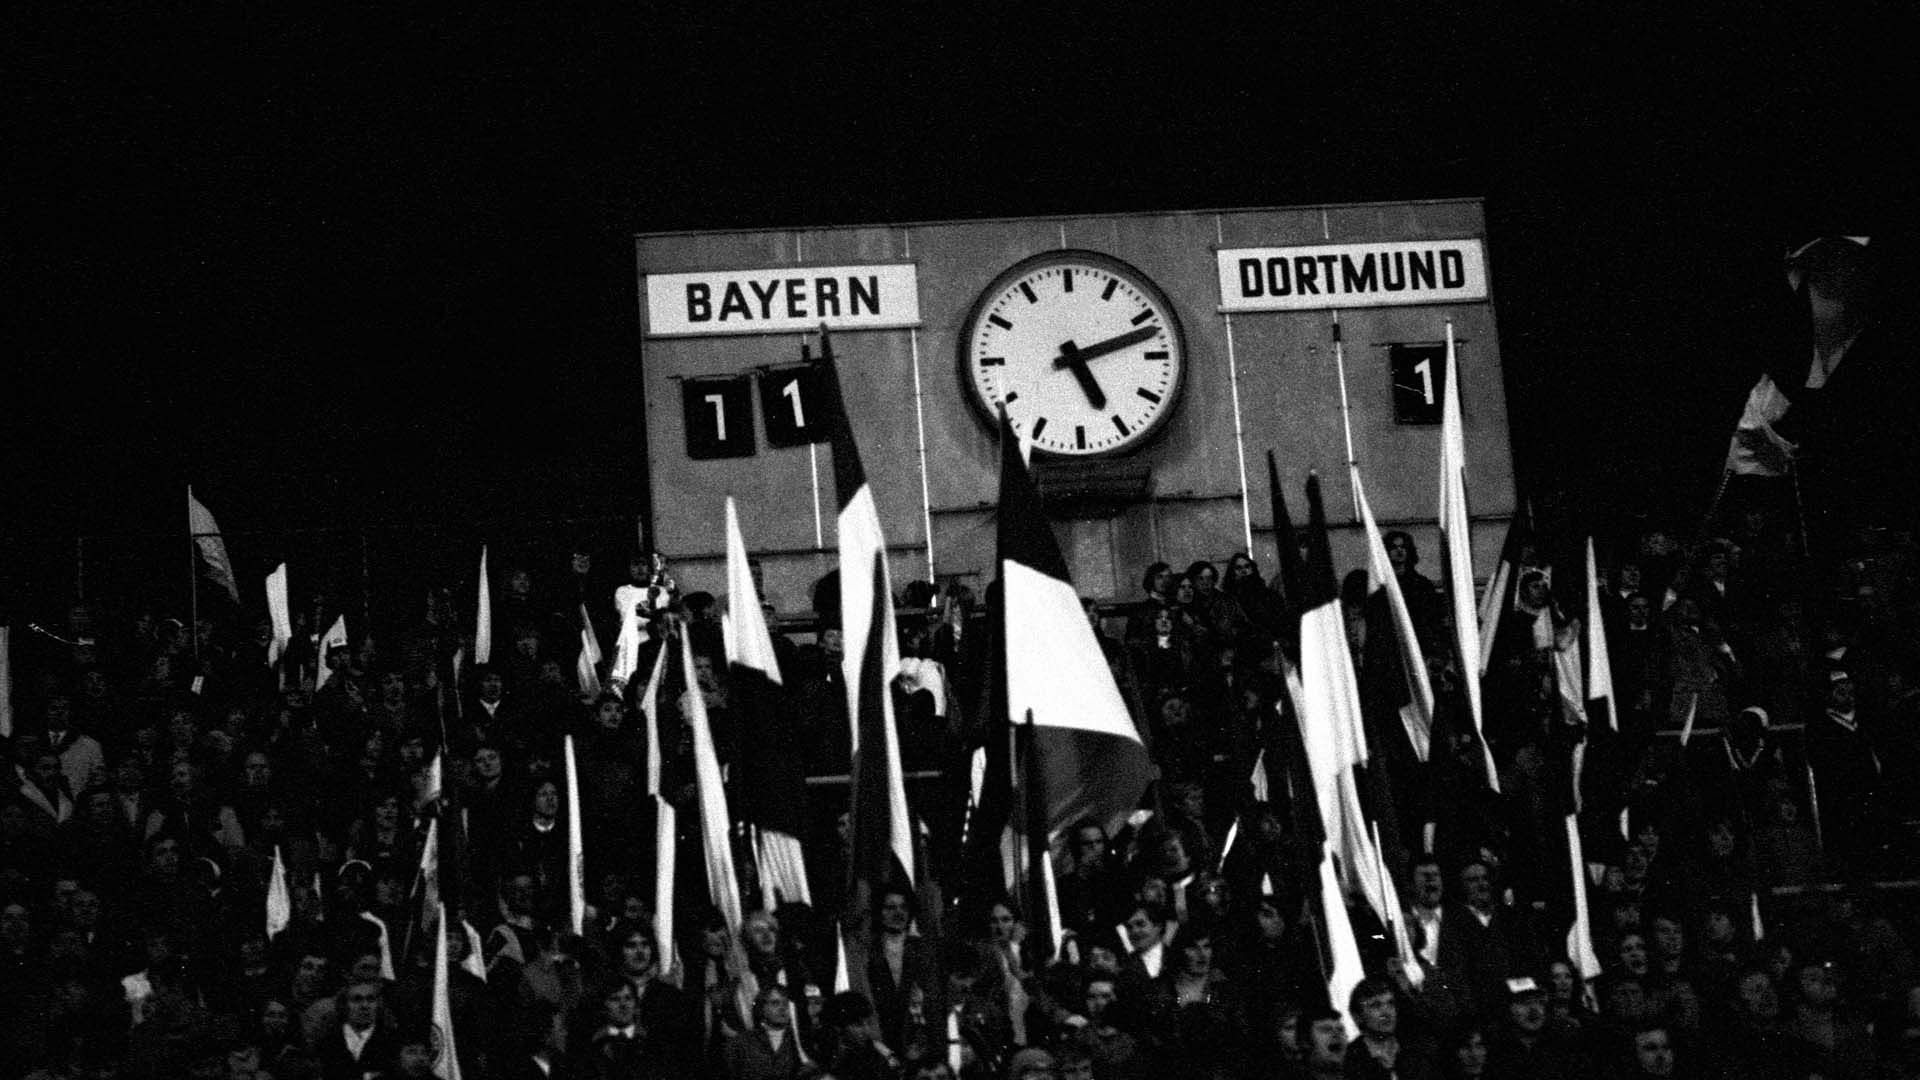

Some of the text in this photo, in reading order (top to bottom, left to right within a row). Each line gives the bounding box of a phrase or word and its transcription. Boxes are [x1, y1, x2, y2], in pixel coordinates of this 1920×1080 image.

[1239, 249, 1465, 298] DORTMUND
[686, 275, 880, 322] BAYERN
[1414, 357, 1435, 406] 1
